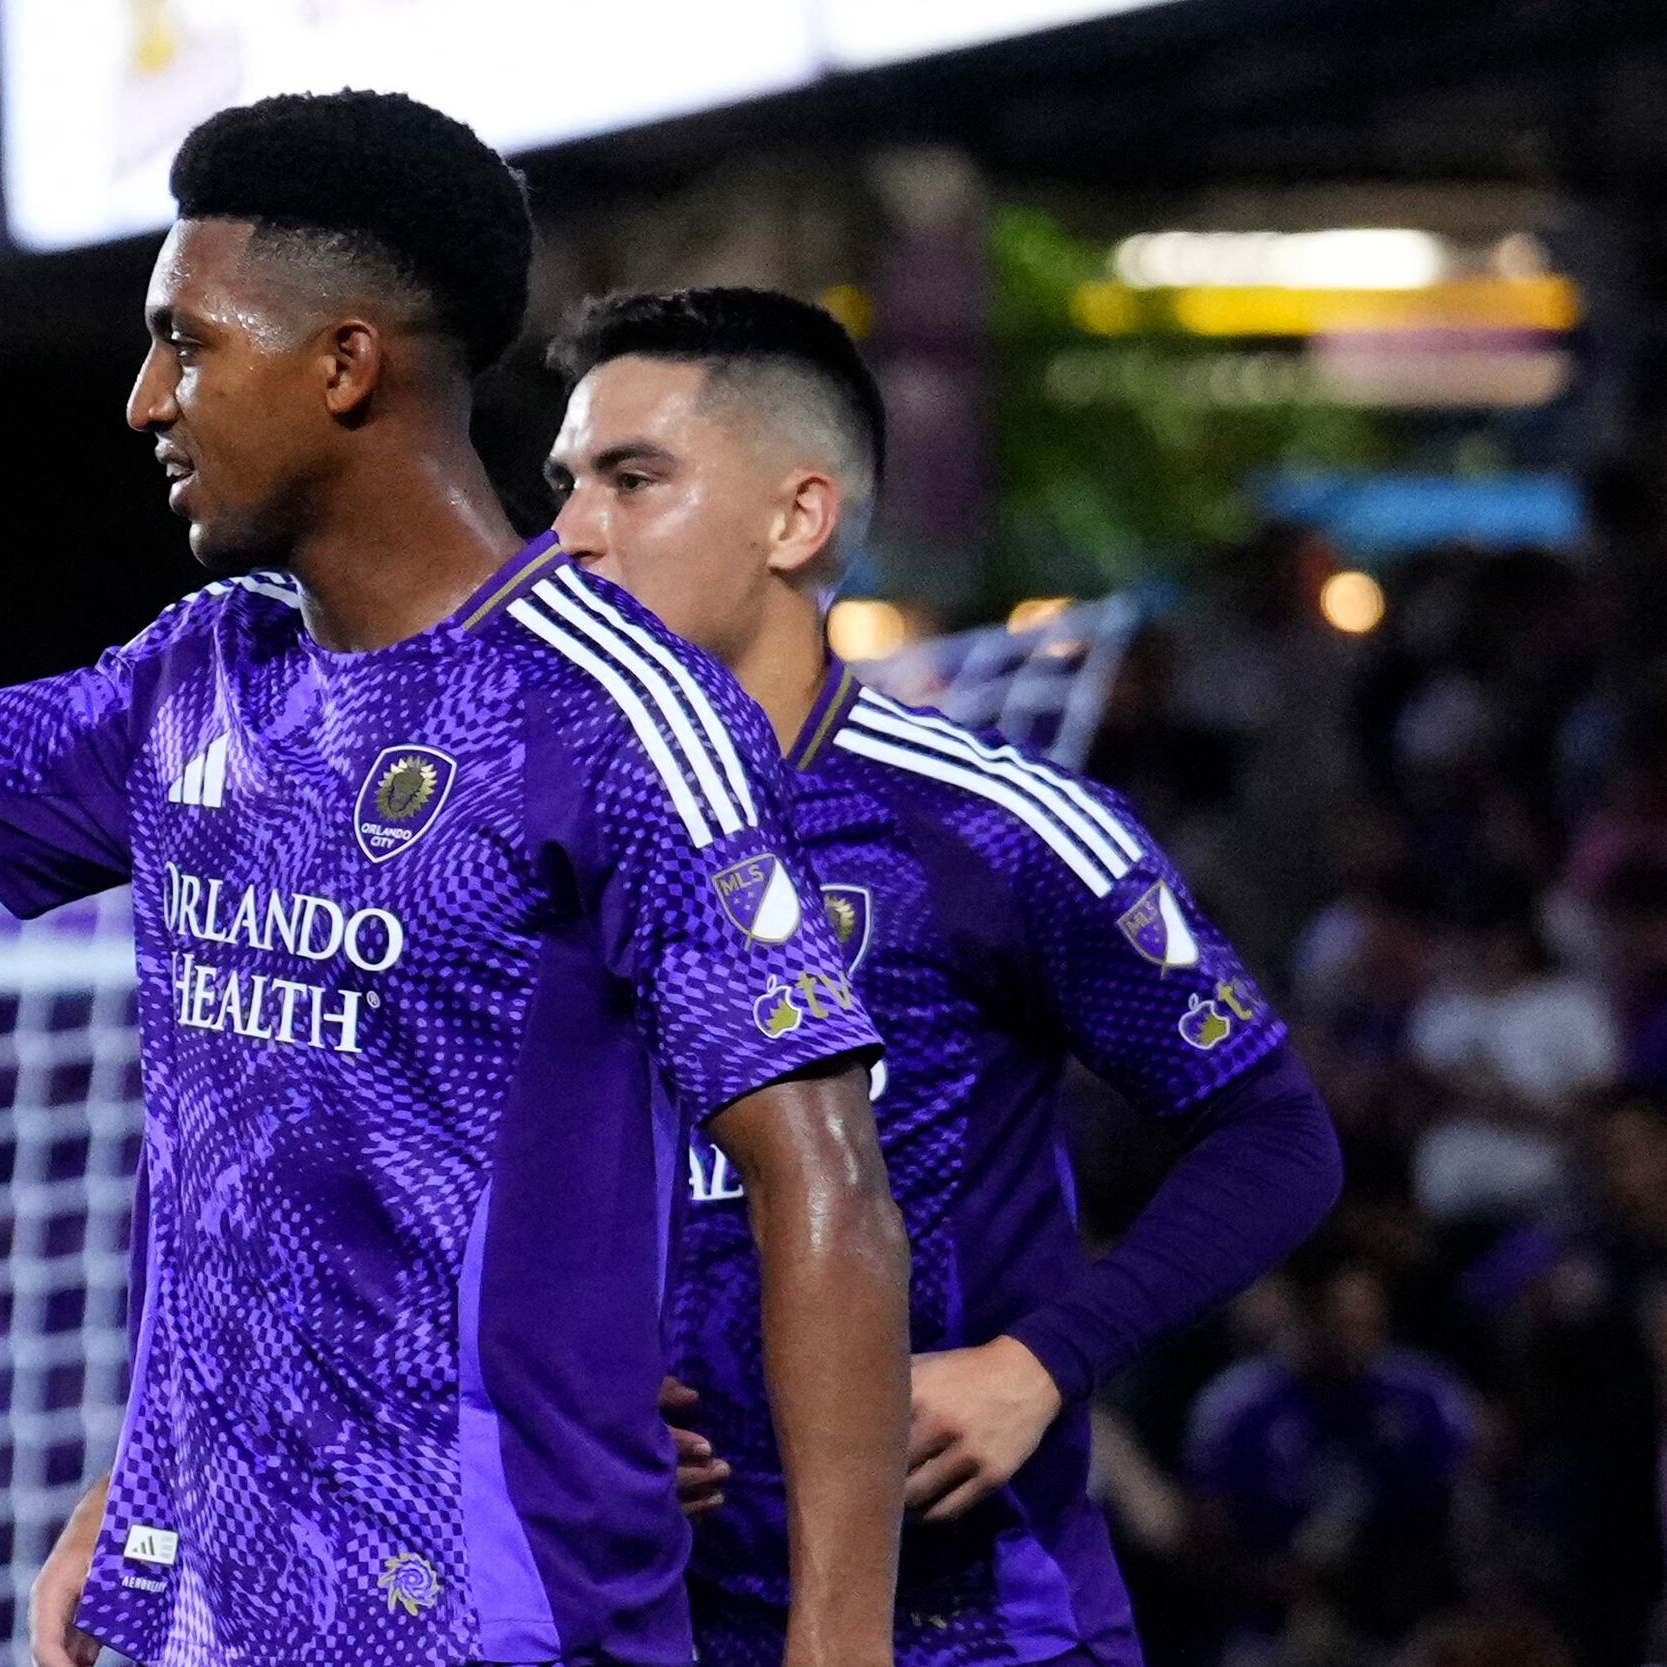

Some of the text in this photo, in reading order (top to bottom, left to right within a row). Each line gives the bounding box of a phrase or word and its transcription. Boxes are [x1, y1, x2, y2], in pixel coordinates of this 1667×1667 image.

[361, 823, 412, 840] ORLANDO
[370, 835, 395, 849] CITY
[719, 864, 764, 896] MLS
[163, 861, 404, 972] ORLANDO
[795, 970, 854, 1019] tv
